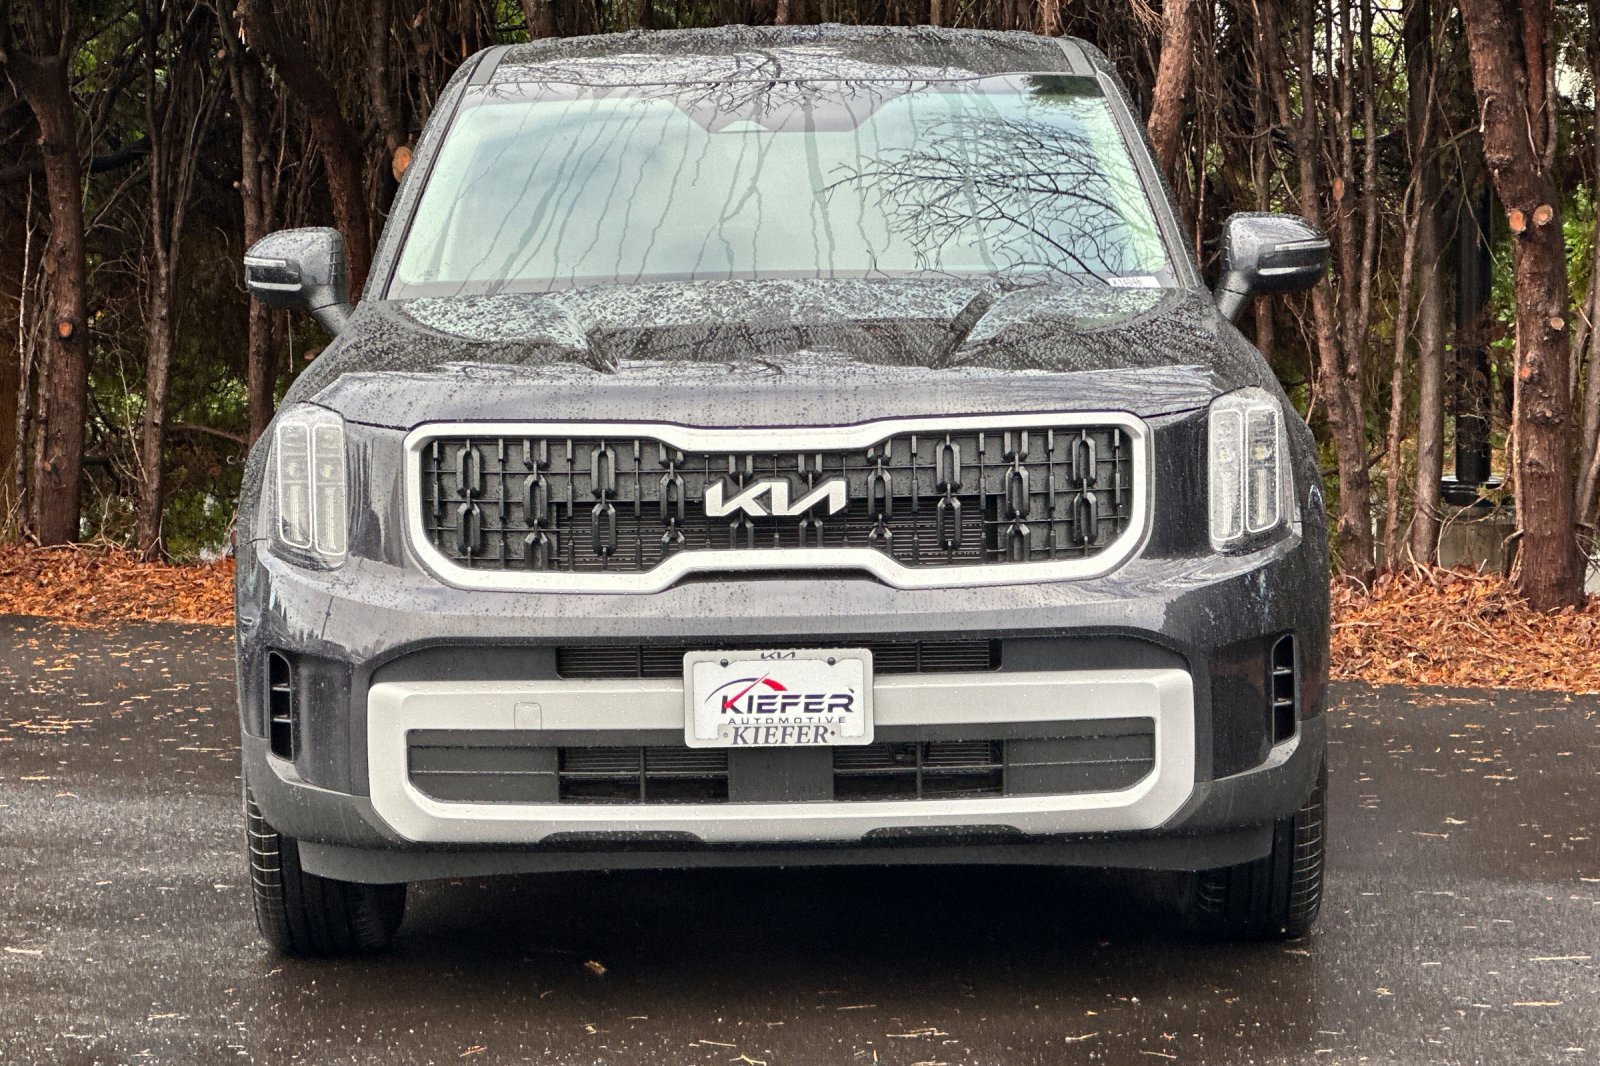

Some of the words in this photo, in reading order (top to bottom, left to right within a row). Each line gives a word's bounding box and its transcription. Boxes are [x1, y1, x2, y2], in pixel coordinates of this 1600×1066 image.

[705, 479, 846, 516] KIA
[761, 651, 795, 659] KIA
[720, 691, 855, 714] KIEFER
[728, 717, 846, 725] AUTOMOTIVE
[732, 725, 829, 745] KIEFER
